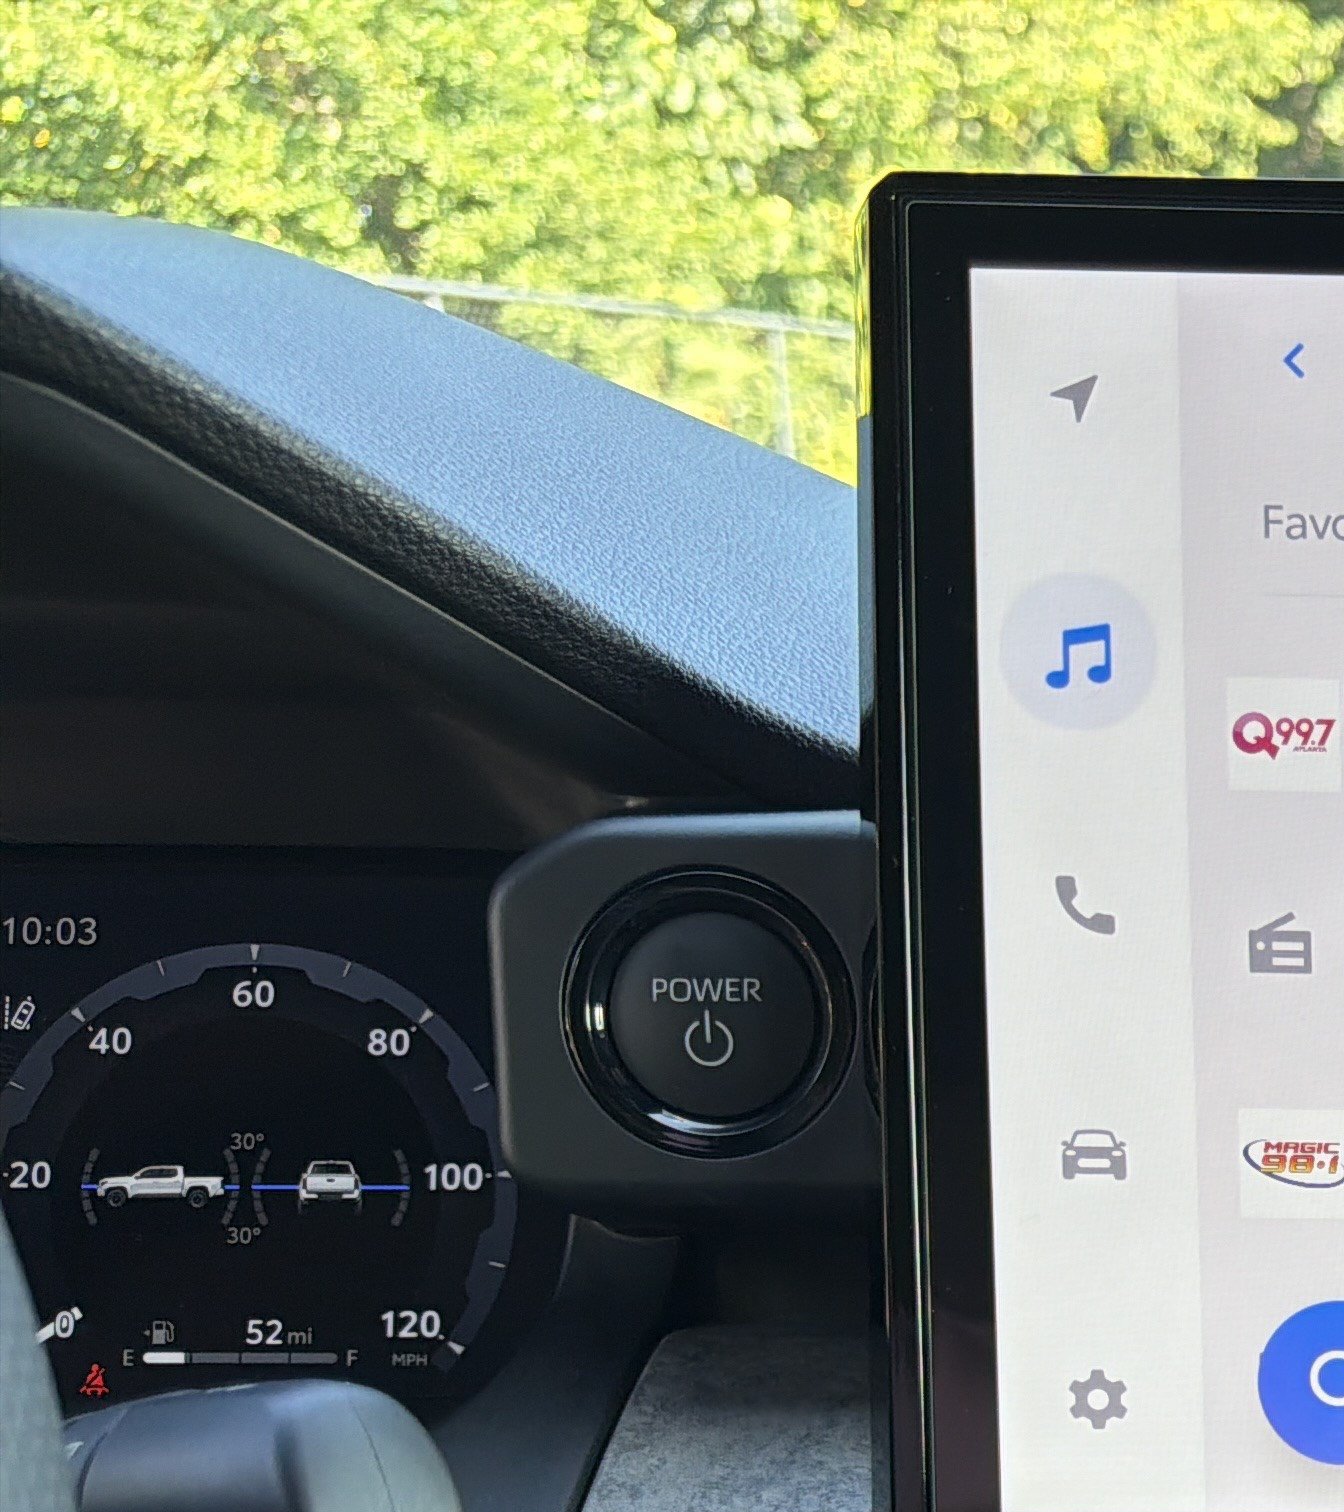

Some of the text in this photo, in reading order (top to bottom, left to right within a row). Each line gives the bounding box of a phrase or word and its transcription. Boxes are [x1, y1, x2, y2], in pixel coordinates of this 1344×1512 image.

[3, 917, 96, 945] 10:03
[233, 981, 274, 1007] 60
[652, 978, 760, 1002] POWER
[88, 1027, 131, 1054] 40
[366, 1028, 411, 1057] 80
[1263, 1141, 1340, 1154] MAGIC
[10, 1161, 50, 1189] 20
[424, 1162, 483, 1192] 100
[54, 1310, 74, 1340] 0
[246, 1320, 312, 1344] 52 mi
[381, 1310, 441, 1338] 120
[123, 1349, 133, 1366] E
[347, 1350, 358, 1366] F
[392, 1354, 427, 1365] MPH
